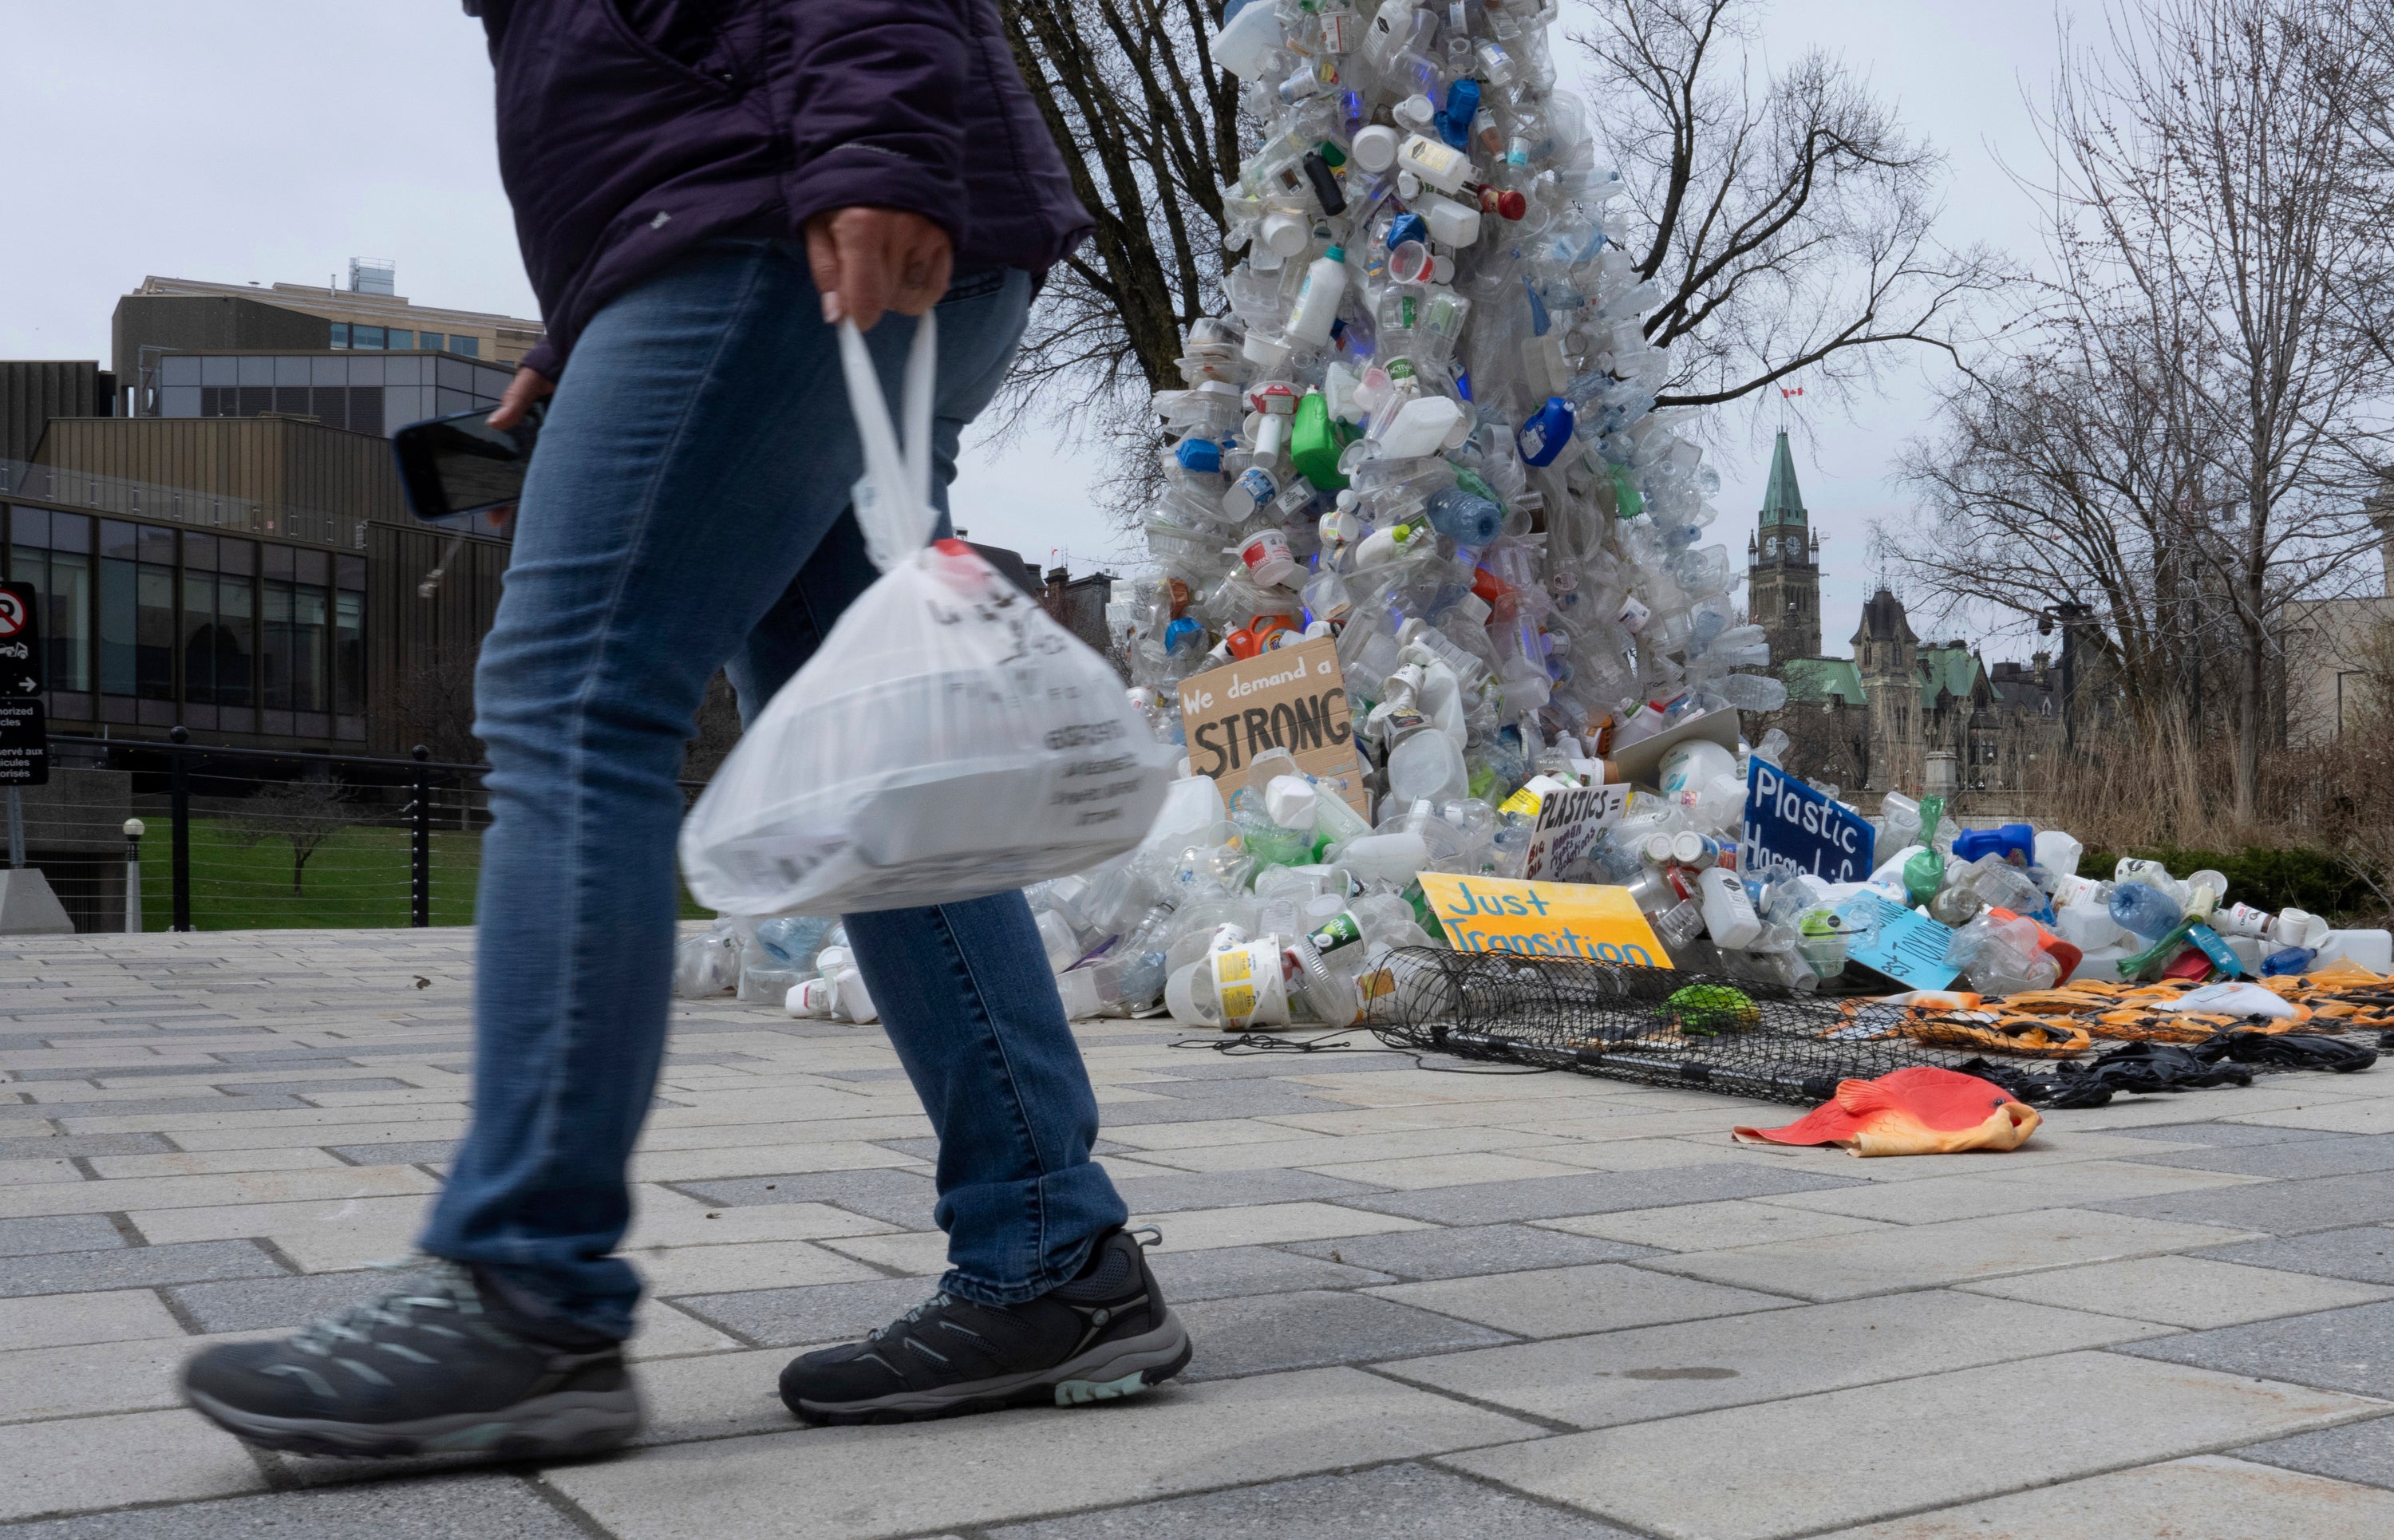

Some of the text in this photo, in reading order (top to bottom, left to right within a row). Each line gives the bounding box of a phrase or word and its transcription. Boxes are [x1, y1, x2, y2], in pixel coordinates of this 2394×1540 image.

[1183, 656, 1332, 716] We demand a
[1195, 687, 1351, 780] STRONG
[0, 758, 30, 767] icules
[0, 768, 30, 777] orisés
[1535, 790, 1609, 832] PLASTICS
[1756, 767, 1857, 854] Plastic
[1527, 858, 1543, 880] OIL
[1448, 882, 1551, 916] Just
[1329, 918, 1349, 941] CTIVIA
[1442, 918, 1655, 968] Transition
